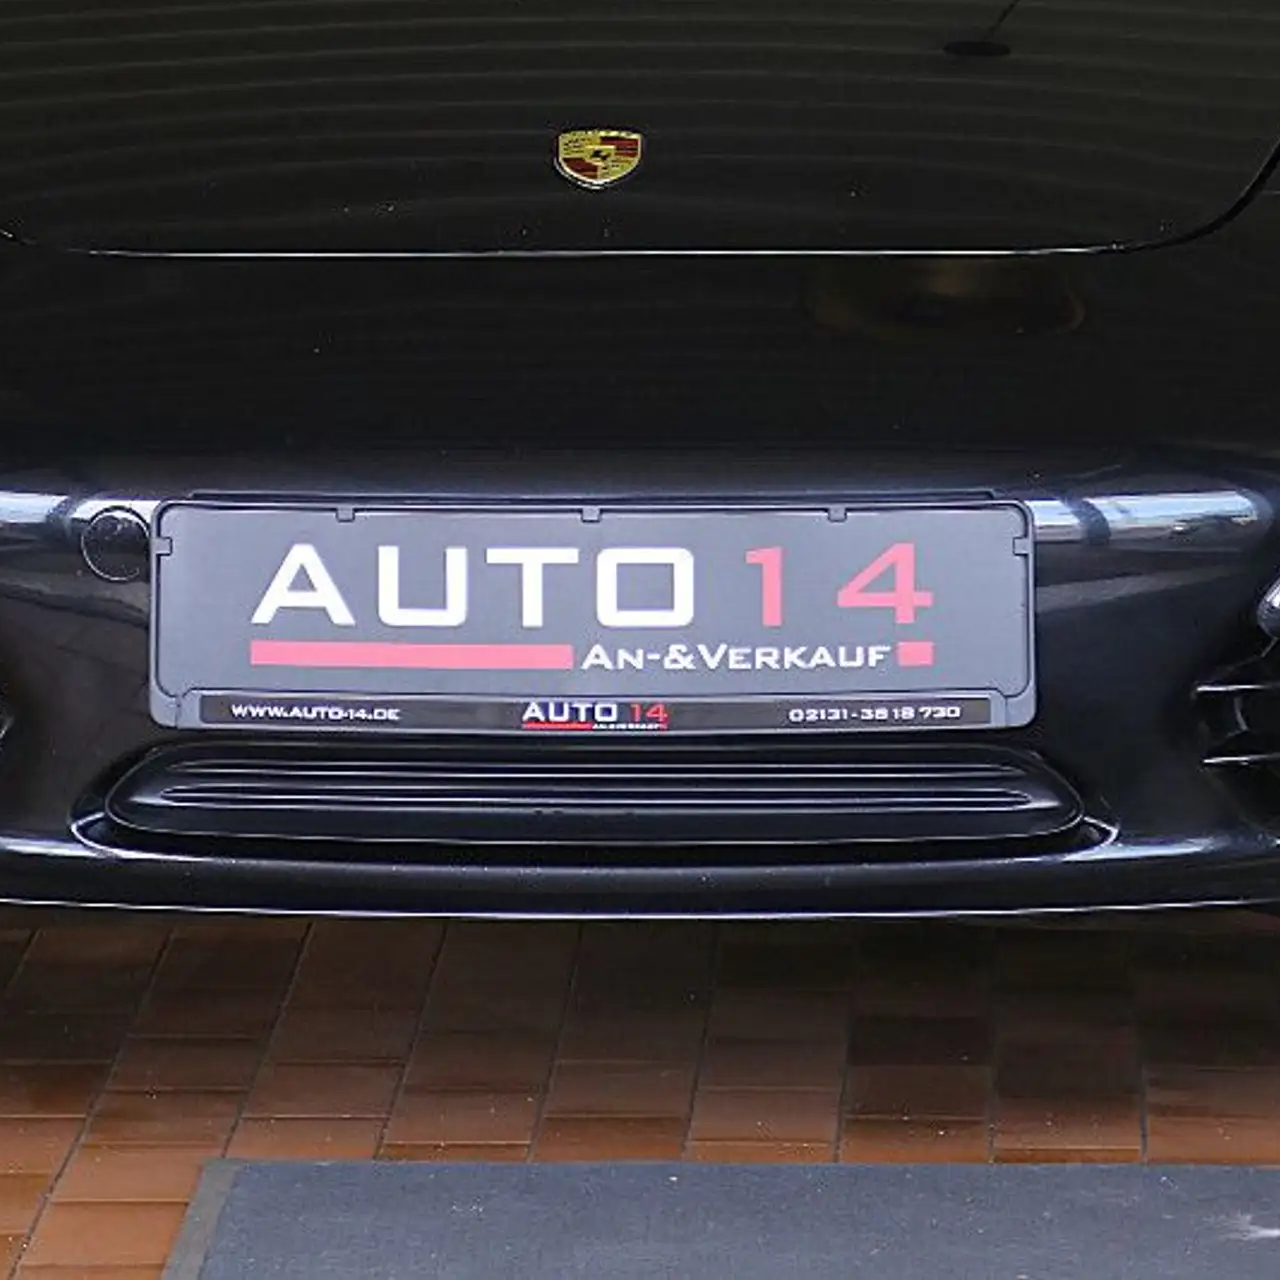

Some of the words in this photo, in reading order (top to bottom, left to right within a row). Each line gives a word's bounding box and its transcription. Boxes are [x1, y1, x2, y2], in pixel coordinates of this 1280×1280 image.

[251, 543, 694, 628] AUTO
[745, 541, 934, 626] 14
[522, 702, 618, 723] AUTO
[630, 702, 669, 723] 14
